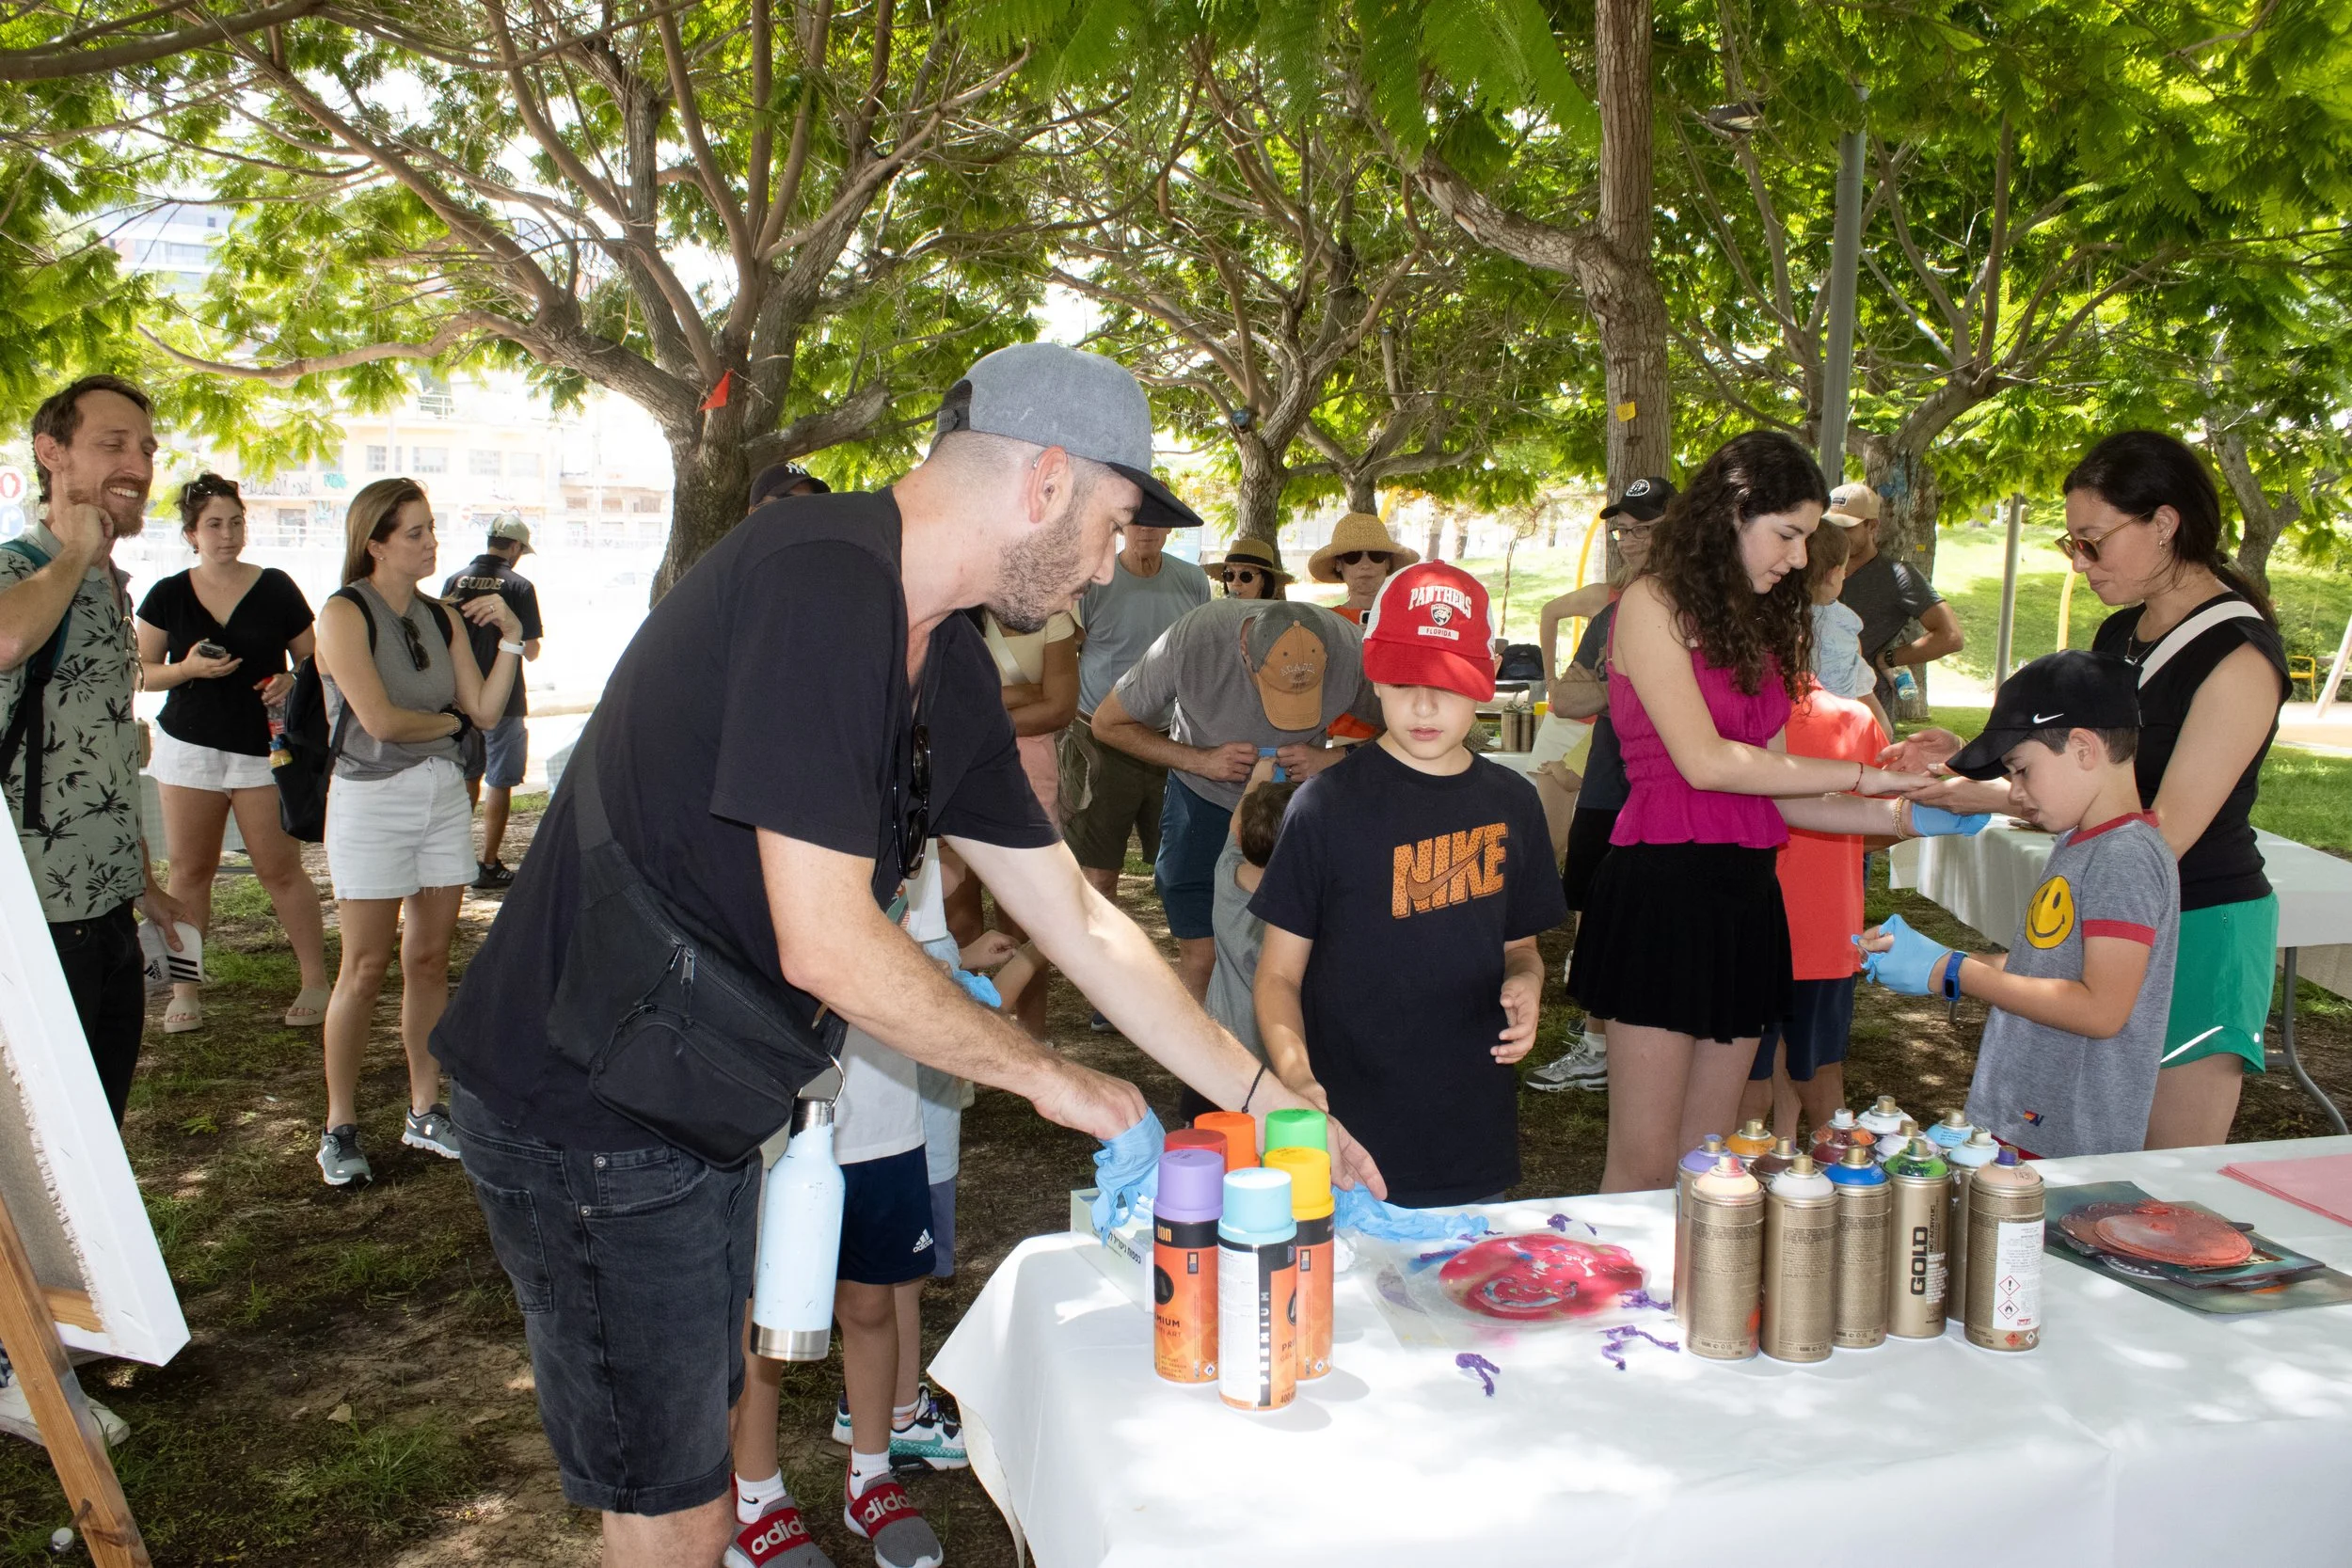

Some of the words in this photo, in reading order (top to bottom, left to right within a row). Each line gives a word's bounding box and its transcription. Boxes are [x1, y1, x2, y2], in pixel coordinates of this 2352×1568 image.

[457, 576, 506, 590] GUIDE
[1407, 584, 1472, 620] PANTHERS
[1425, 627, 1452, 638] FLORIDA
[1391, 822, 1509, 920] NIKE
[1910, 1227, 1928, 1295] GOLD
